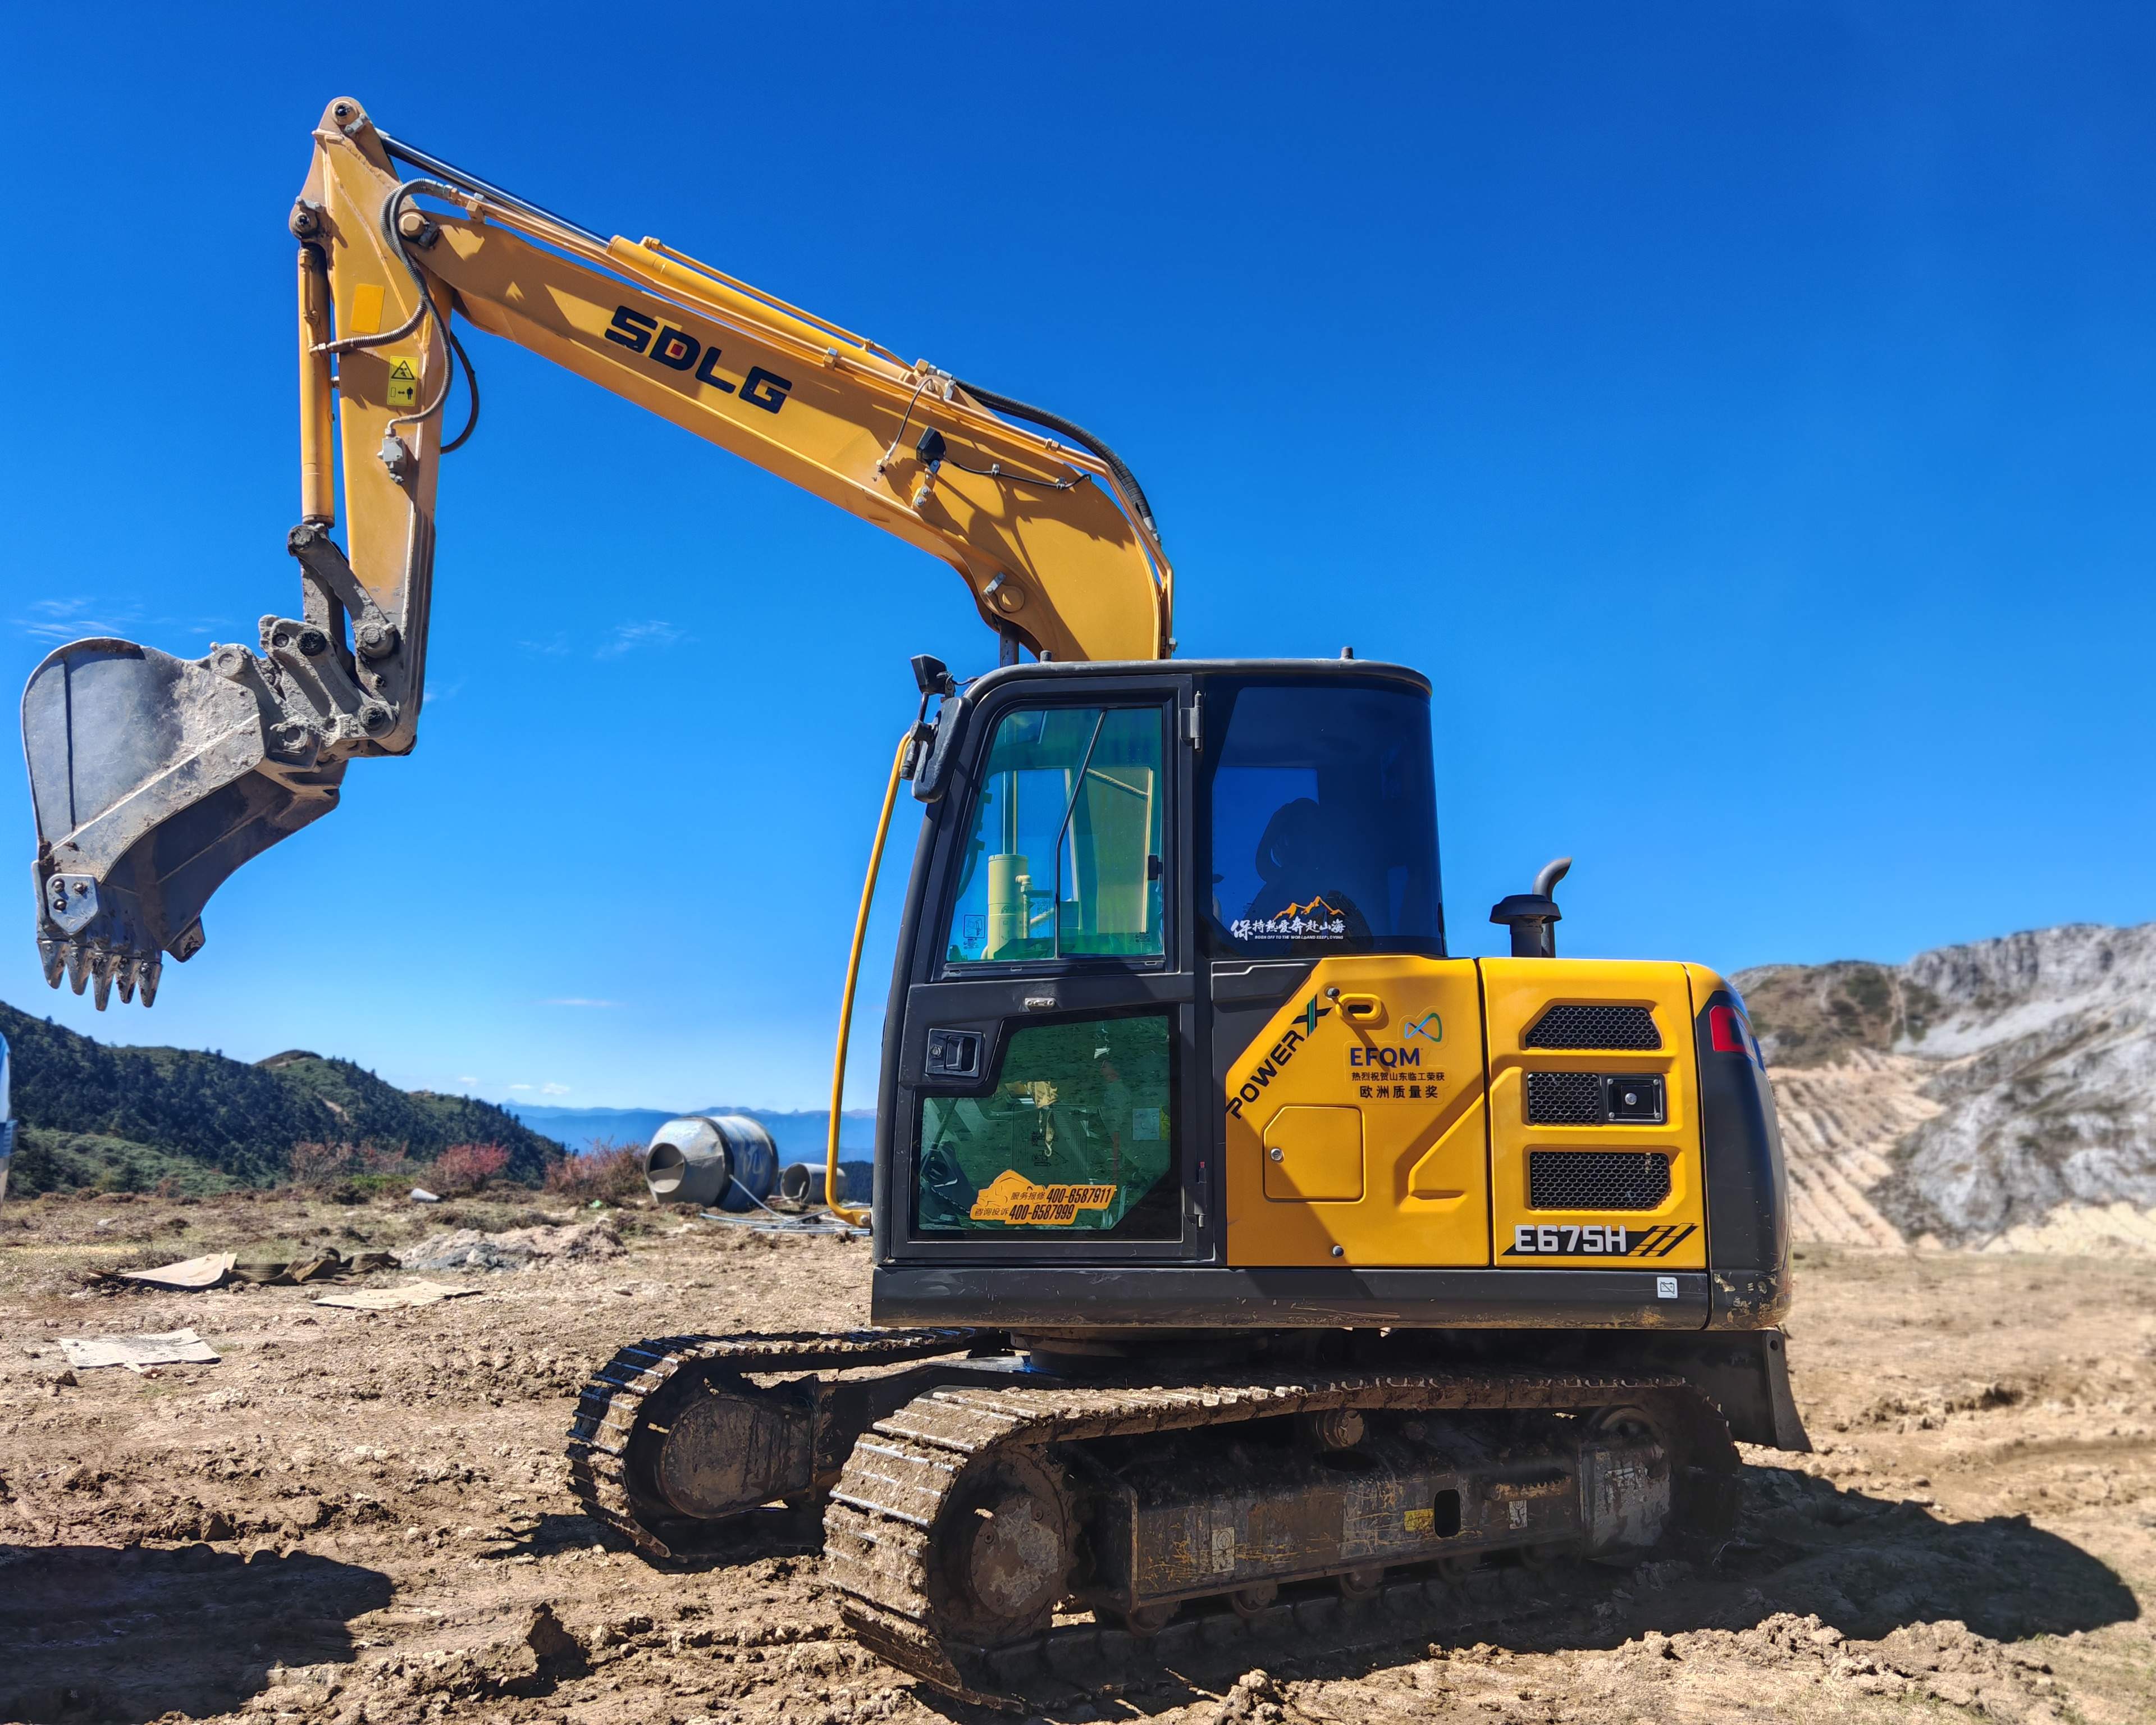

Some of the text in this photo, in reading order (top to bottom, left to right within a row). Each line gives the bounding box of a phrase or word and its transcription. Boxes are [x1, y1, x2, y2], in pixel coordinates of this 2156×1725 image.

[604, 305, 792, 414] SDLG
[1350, 1047, 1420, 1068] EFQM
[1351, 1072, 1445, 1081] 热烈祝贺山东临工荣获
[1360, 1085, 1438, 1098] 欧洲质量奖
[1011, 1188, 1112, 1203] 服务报修 400-6587911
[975, 1204, 1075, 1220] 咨询投诉 400-6587999
[1514, 1225, 1627, 1252] E675H
